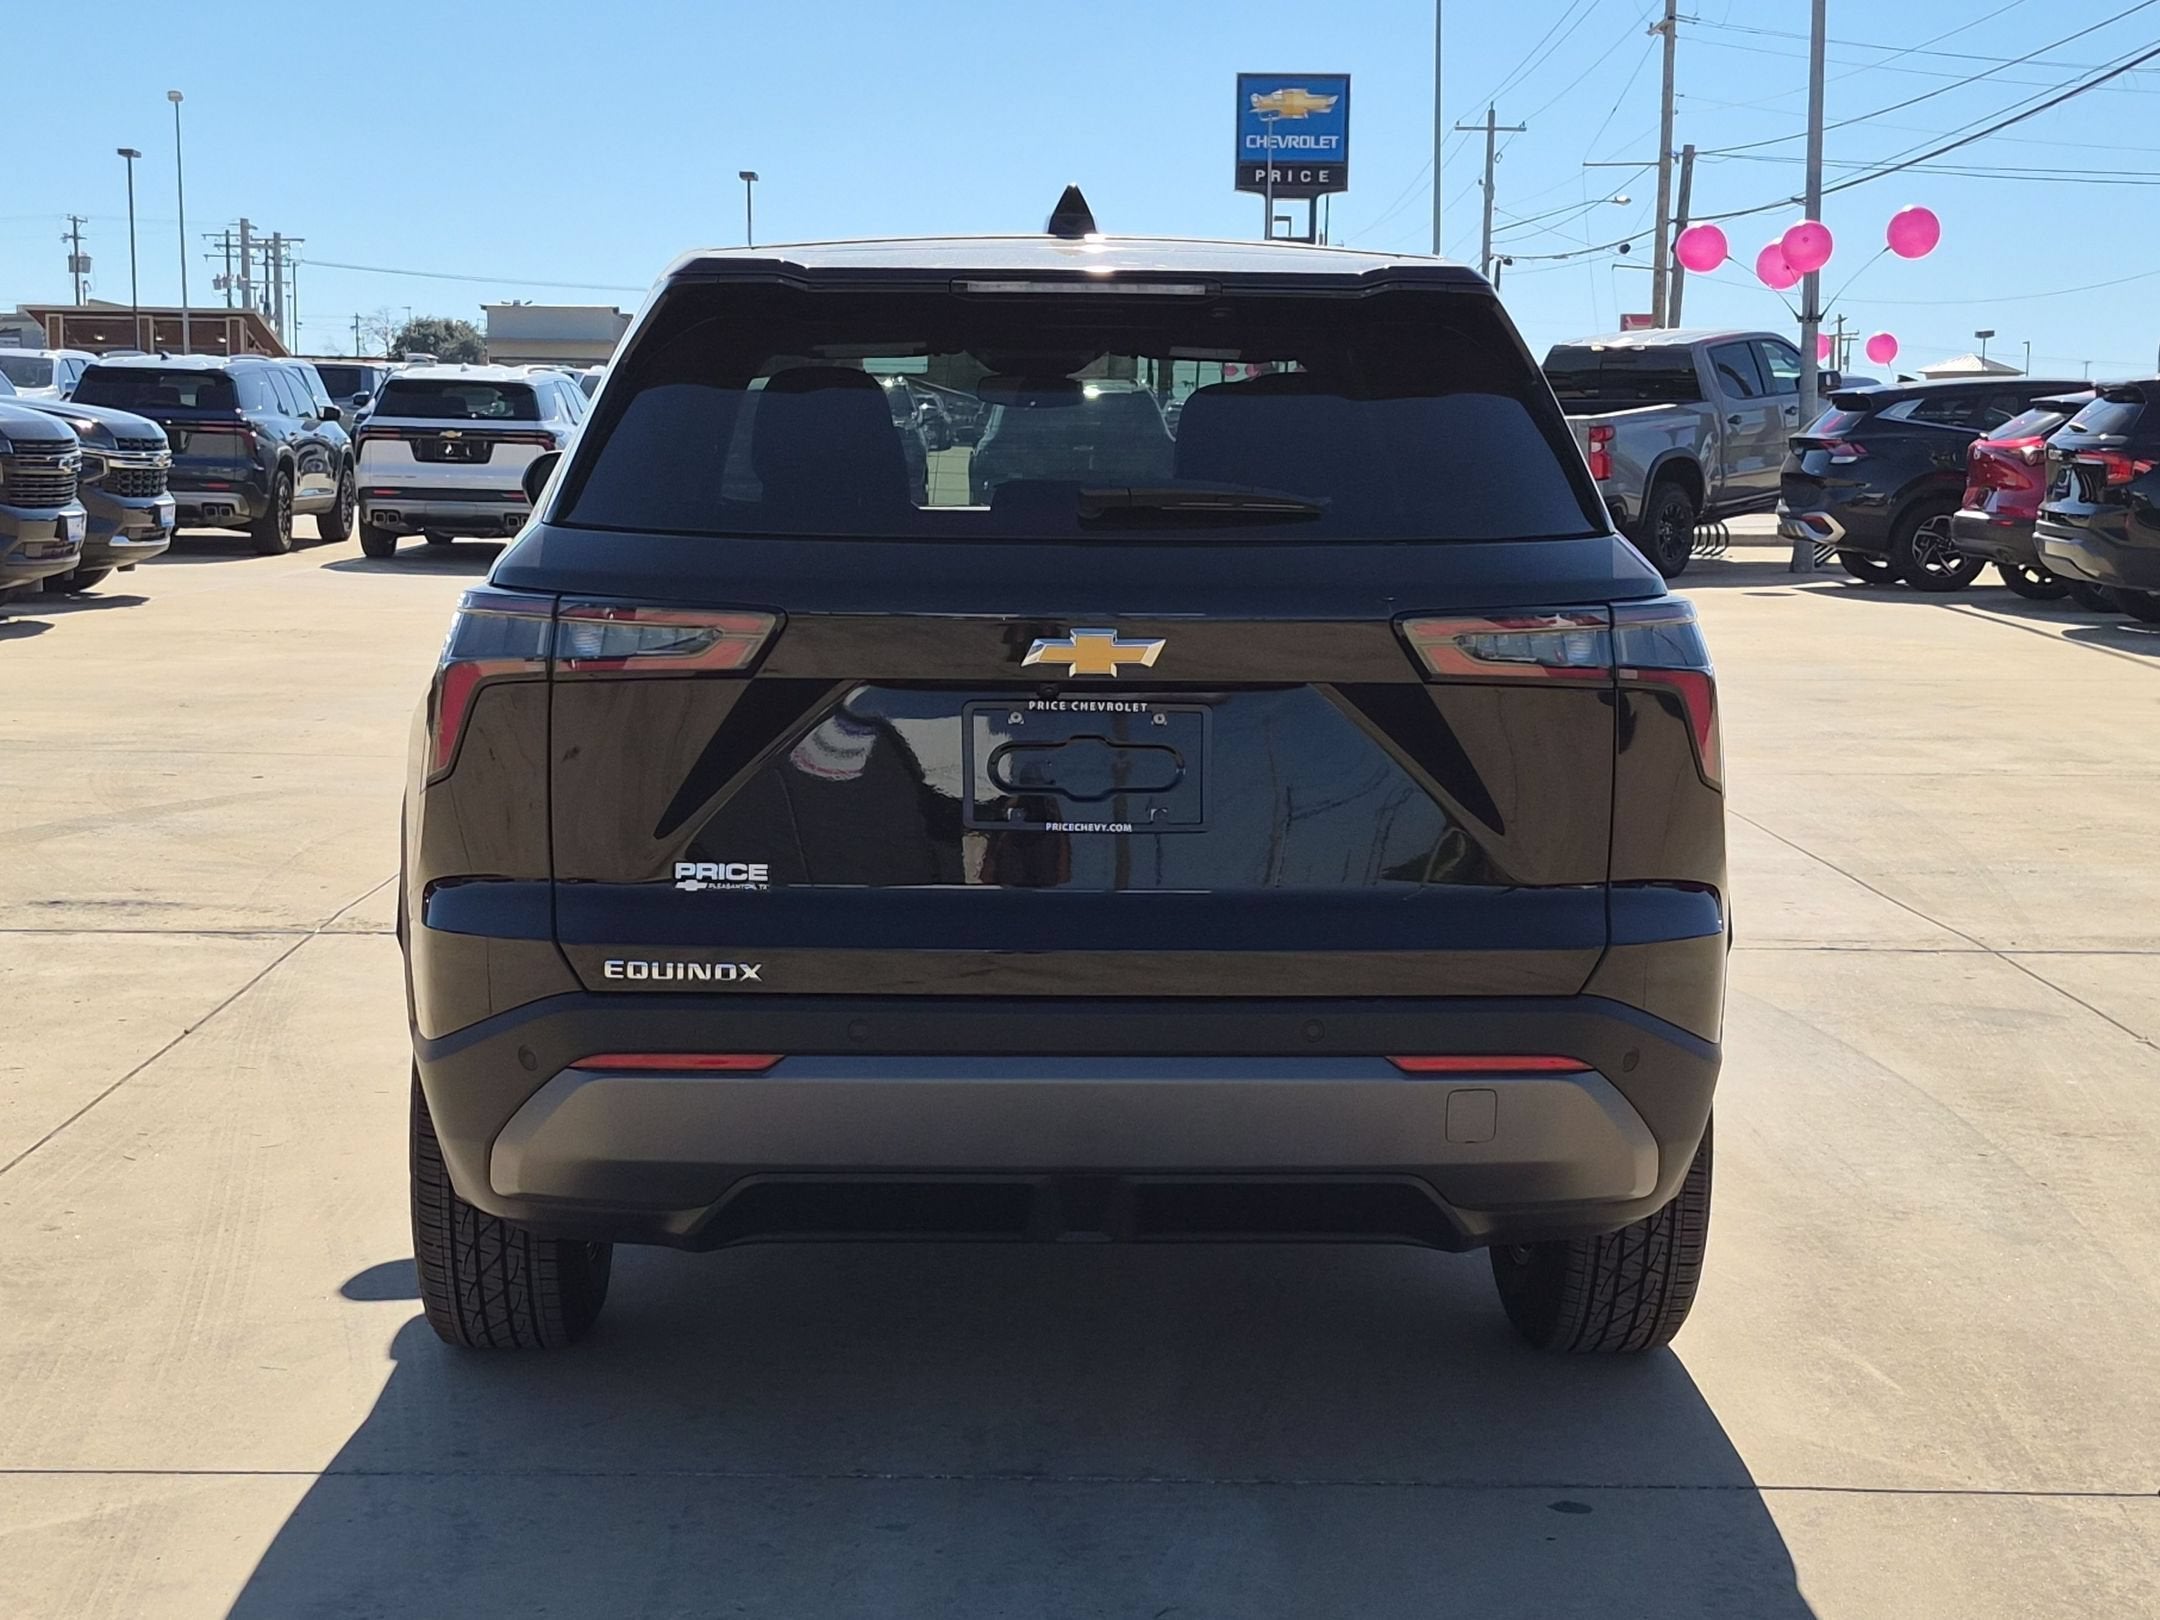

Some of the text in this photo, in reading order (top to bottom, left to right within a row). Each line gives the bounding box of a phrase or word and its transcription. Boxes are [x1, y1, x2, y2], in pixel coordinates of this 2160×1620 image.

[1246, 135, 1339, 149] CHEVROLET
[1255, 169, 1329, 183] PRICE
[1028, 700, 1148, 712] PRICE CHEVROLET
[1045, 822, 1132, 832] PRICECHEVY.COM
[675, 862, 769, 881] PRICE
[604, 960, 762, 981] EQUINOX
